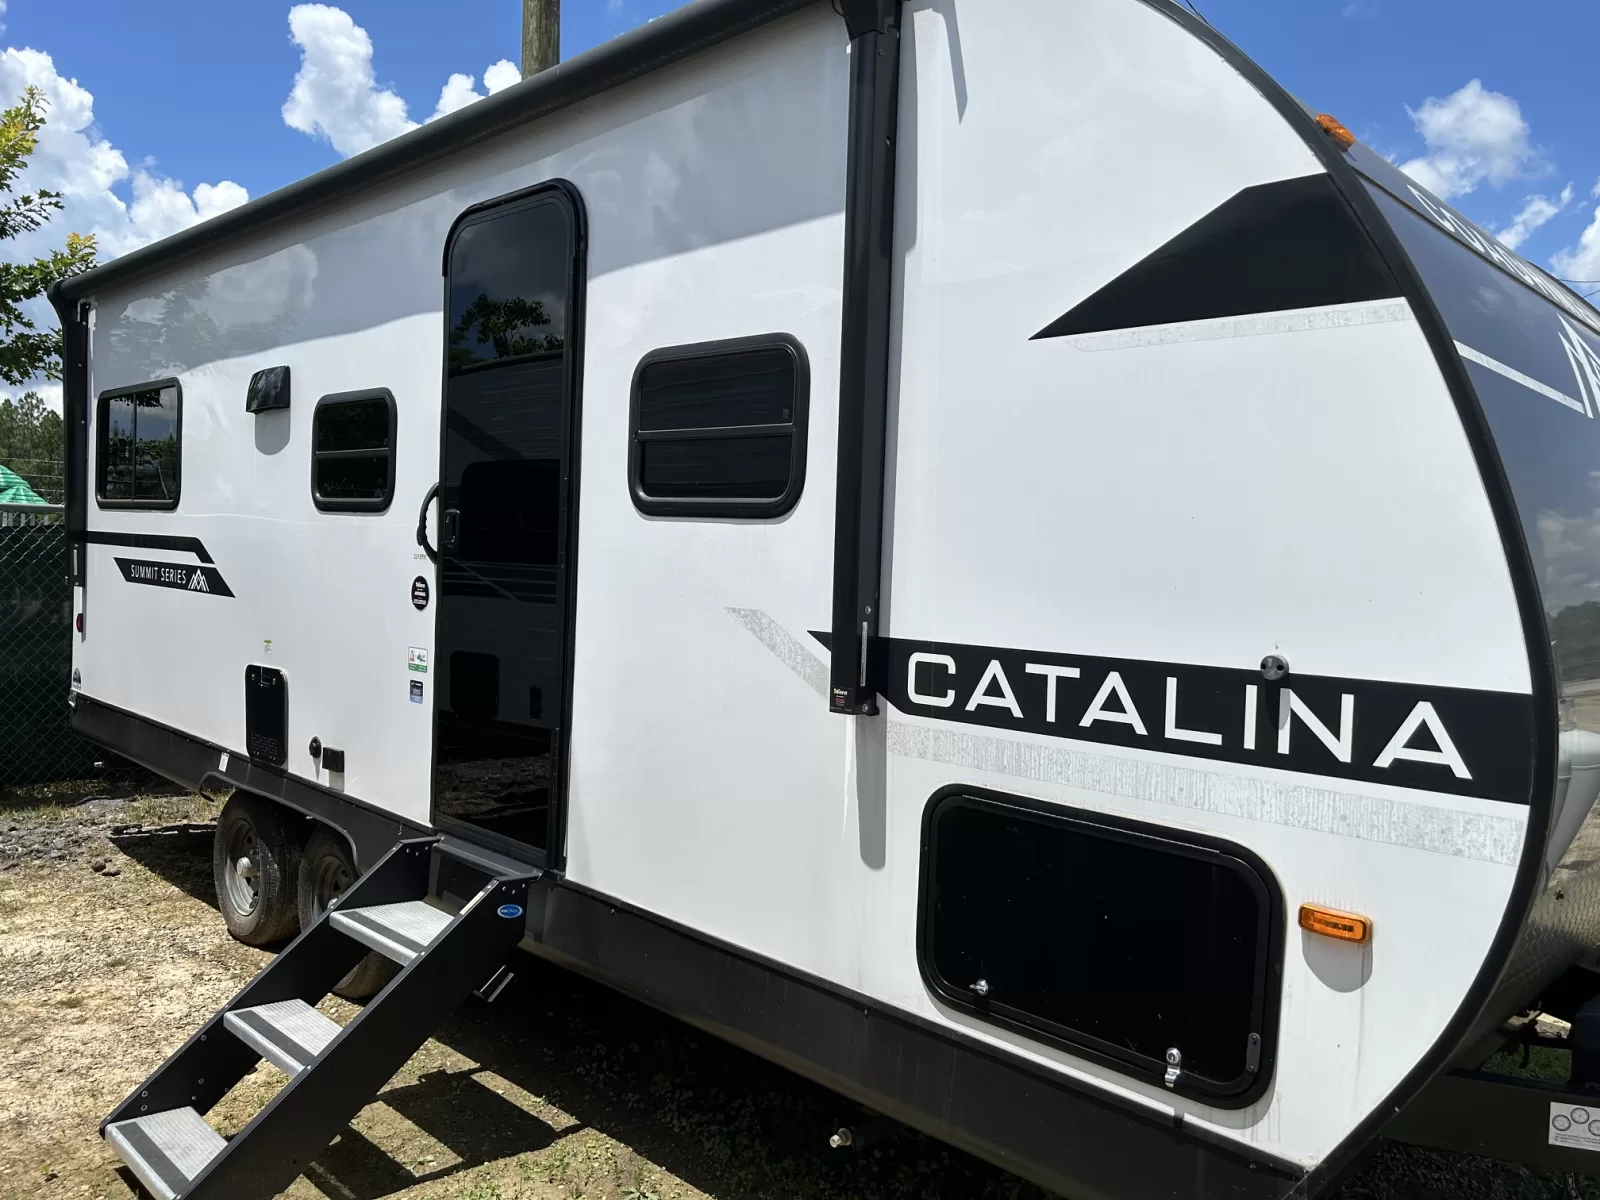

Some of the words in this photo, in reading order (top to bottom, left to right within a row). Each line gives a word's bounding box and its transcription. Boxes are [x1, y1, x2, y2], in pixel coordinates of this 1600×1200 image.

[130, 564, 159, 580] SUMMIT
[160, 567, 187, 584] SERIES
[906, 651, 1474, 780] CATALINA
